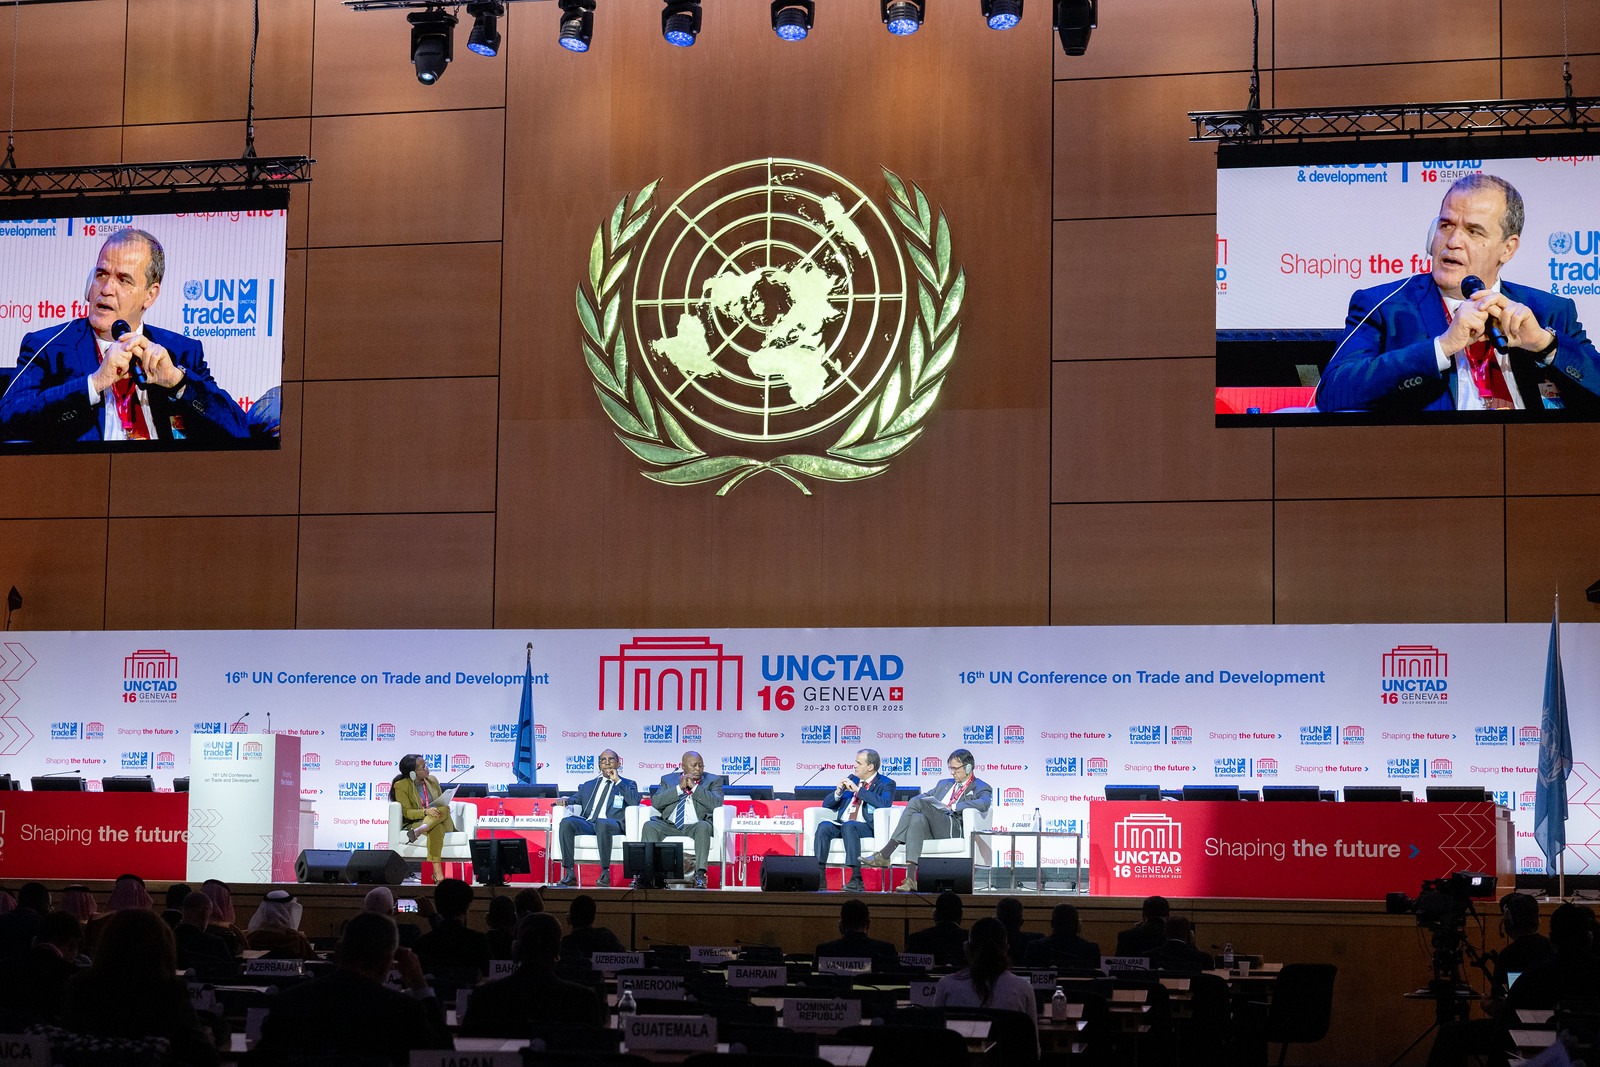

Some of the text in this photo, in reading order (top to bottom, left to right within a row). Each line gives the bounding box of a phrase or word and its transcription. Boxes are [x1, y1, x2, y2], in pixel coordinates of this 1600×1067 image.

[1297, 170, 1387, 184] & development
[1421, 170, 1437, 182] 16
[83, 225, 96, 236] 16
[1281, 253, 1361, 279] Shaping
[1369, 254, 1403, 274] the
[1548, 256, 1600, 281] trad
[204, 279, 235, 301] UN
[1550, 283, 1559, 295] &
[38, 300, 66, 318] the
[182, 302, 235, 324] trade
[183, 326, 256, 339] & development
[762, 654, 904, 681] UNCTAD
[225, 671, 248, 684] 16th
[253, 672, 272, 684] UN
[277, 672, 357, 684] Conference
[361, 674, 378, 684] on
[383, 672, 420, 684] Trade
[425, 672, 450, 684] and
[959, 670, 1325, 686] 16th UN Conference on Trade and Development
[124, 681, 177, 691] UNCTAD
[1382, 680, 1447, 691] UNCTAD
[122, 693, 136, 703] 16
[758, 685, 885, 711] 16 GENEVA
[1381, 693, 1398, 704] 16
[20, 824, 92, 846] Shaping
[98, 826, 129, 842] the
[1205, 838, 1401, 861] Shaping the future
[1114, 851, 1182, 864] UNCTAD
[1113, 865, 1131, 878] 16
[596, 956, 639, 964] UZBEKISTAN
[736, 970, 777, 978] BAHRAIN
[622, 980, 678, 990] CAMEROON
[797, 1002, 847, 1011] DOMINICAN
[800, 1012, 843, 1020] REPUBLIC
[632, 1023, 708, 1037] GUATEMALA
